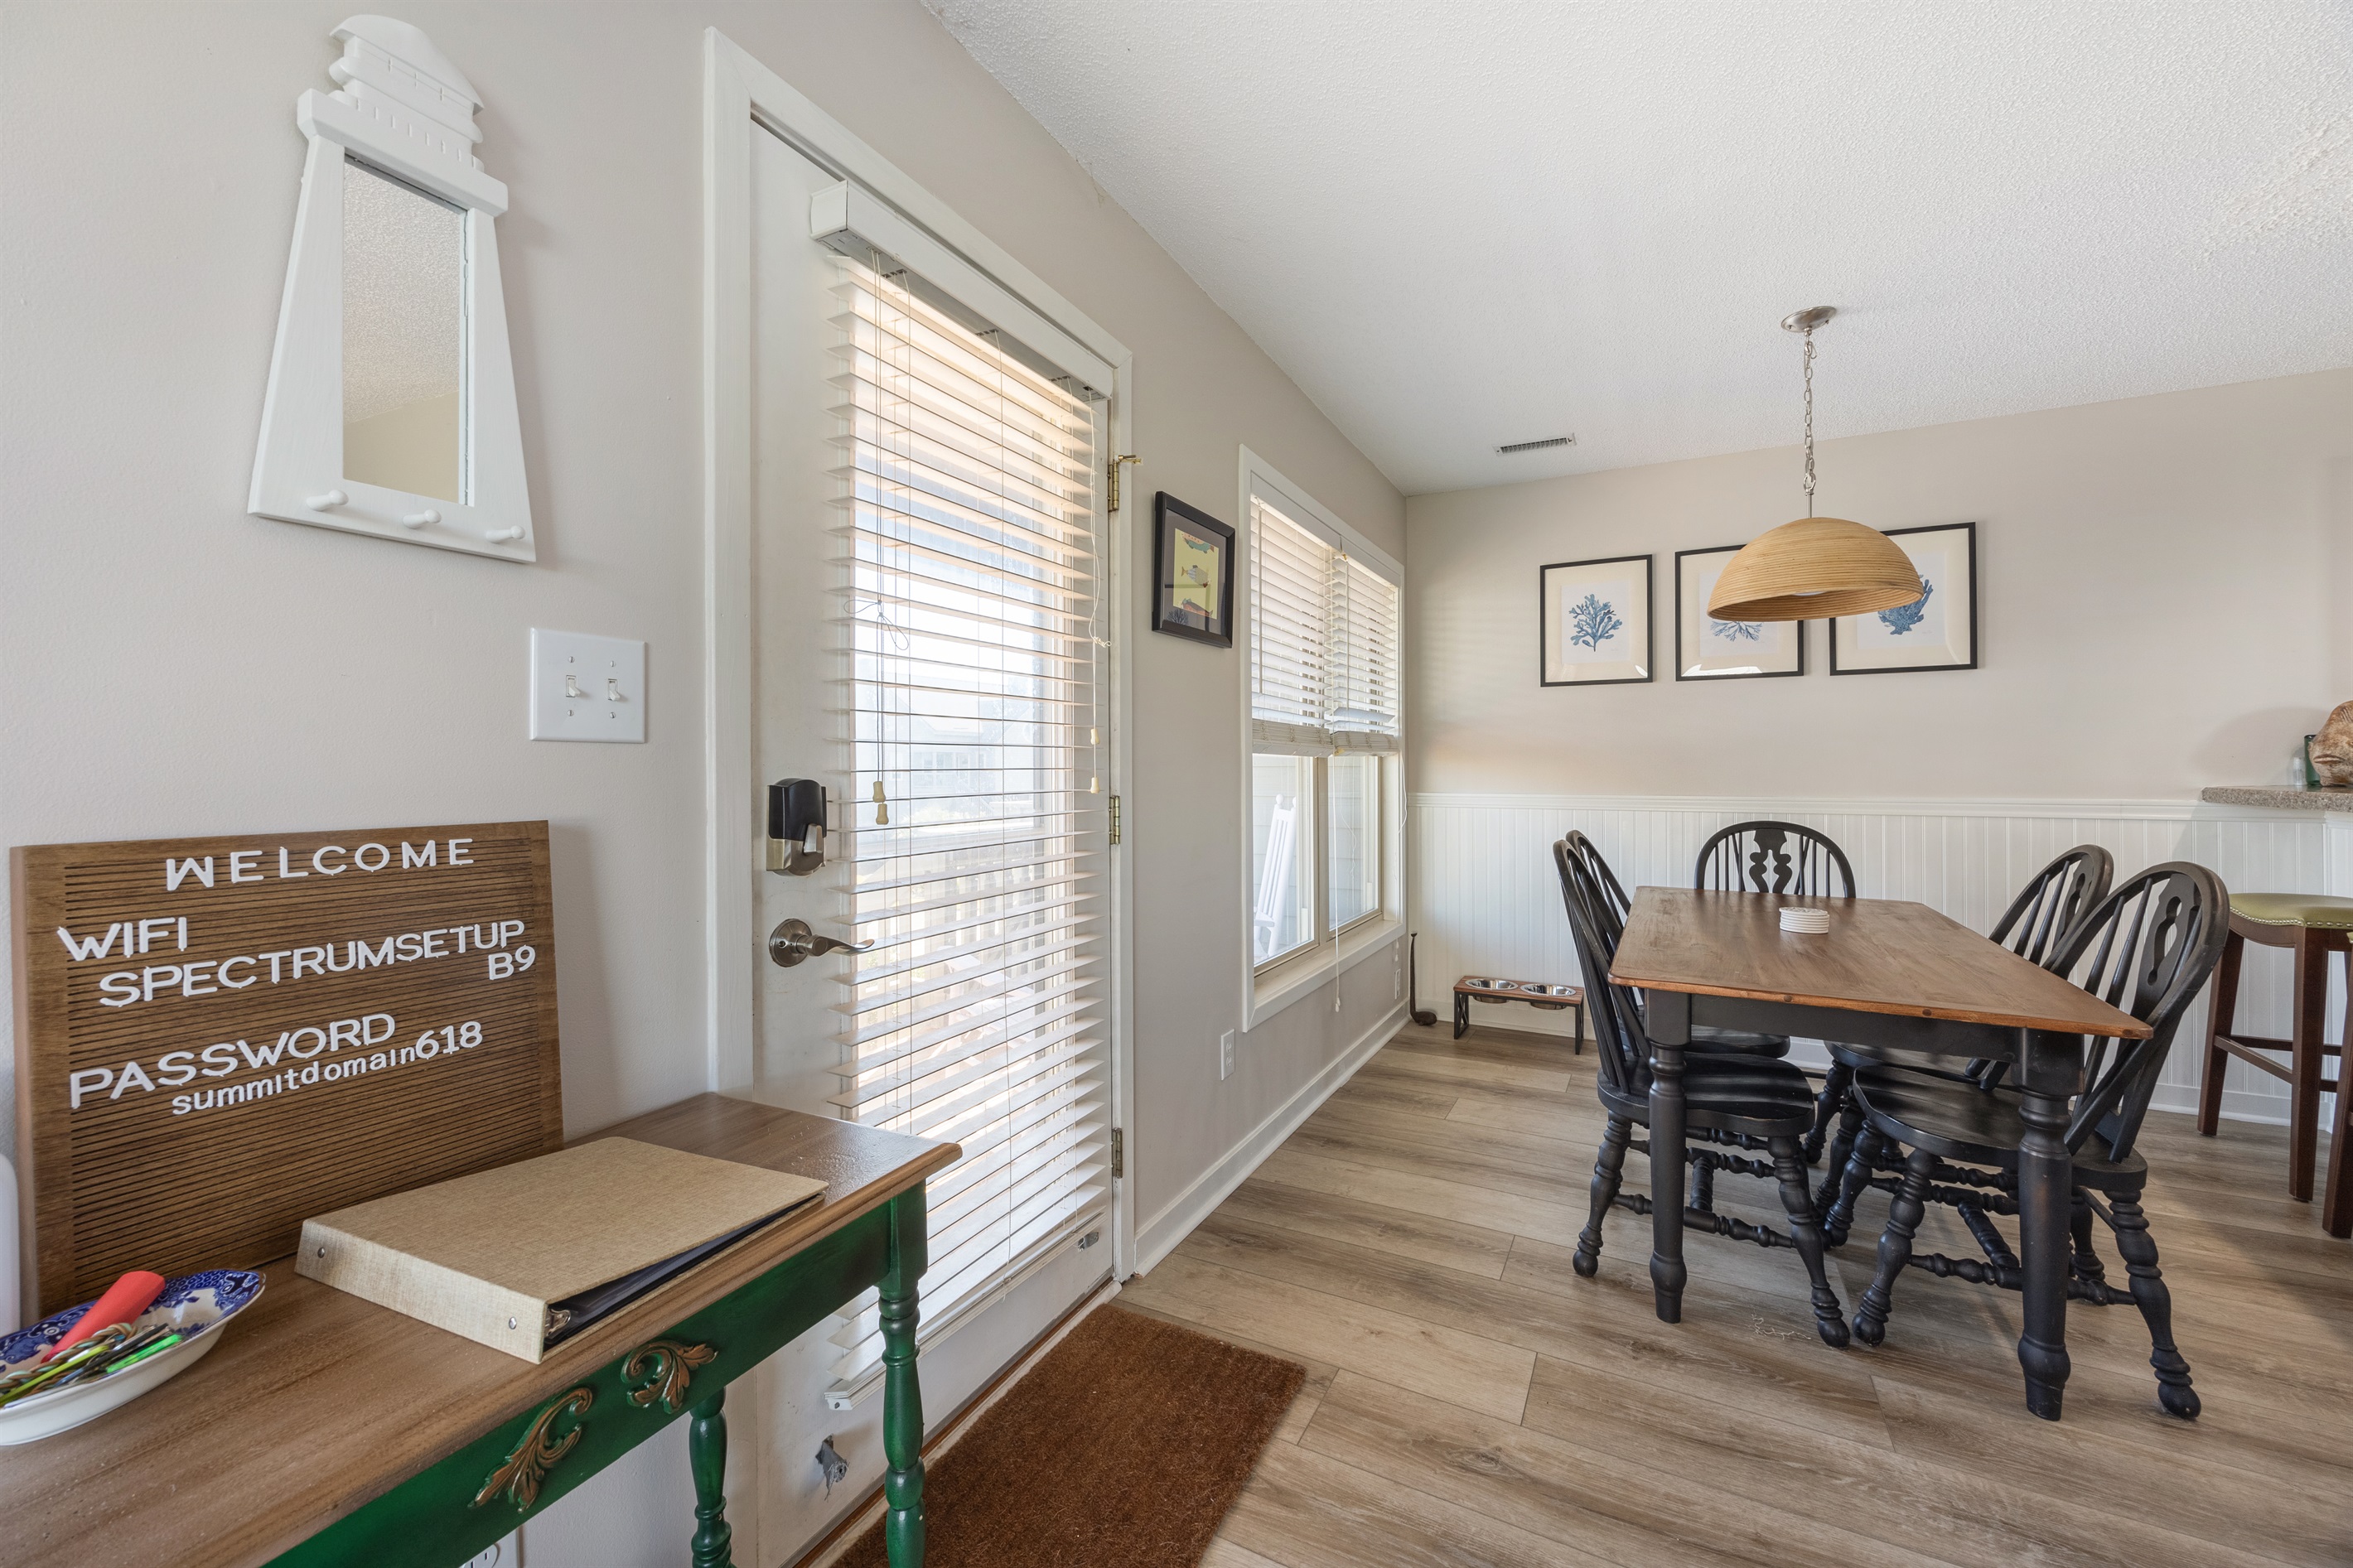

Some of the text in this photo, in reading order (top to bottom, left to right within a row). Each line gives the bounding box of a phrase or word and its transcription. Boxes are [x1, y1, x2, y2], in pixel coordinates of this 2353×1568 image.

[166, 837, 474, 891] WELCOME
[56, 916, 188, 962] WIFI
[99, 919, 525, 1008] SPECTRUMSETUP
[487, 944, 536, 981] B9
[70, 1013, 395, 1110] PASSWORD
[172, 1020, 483, 1115] summitdomain618
